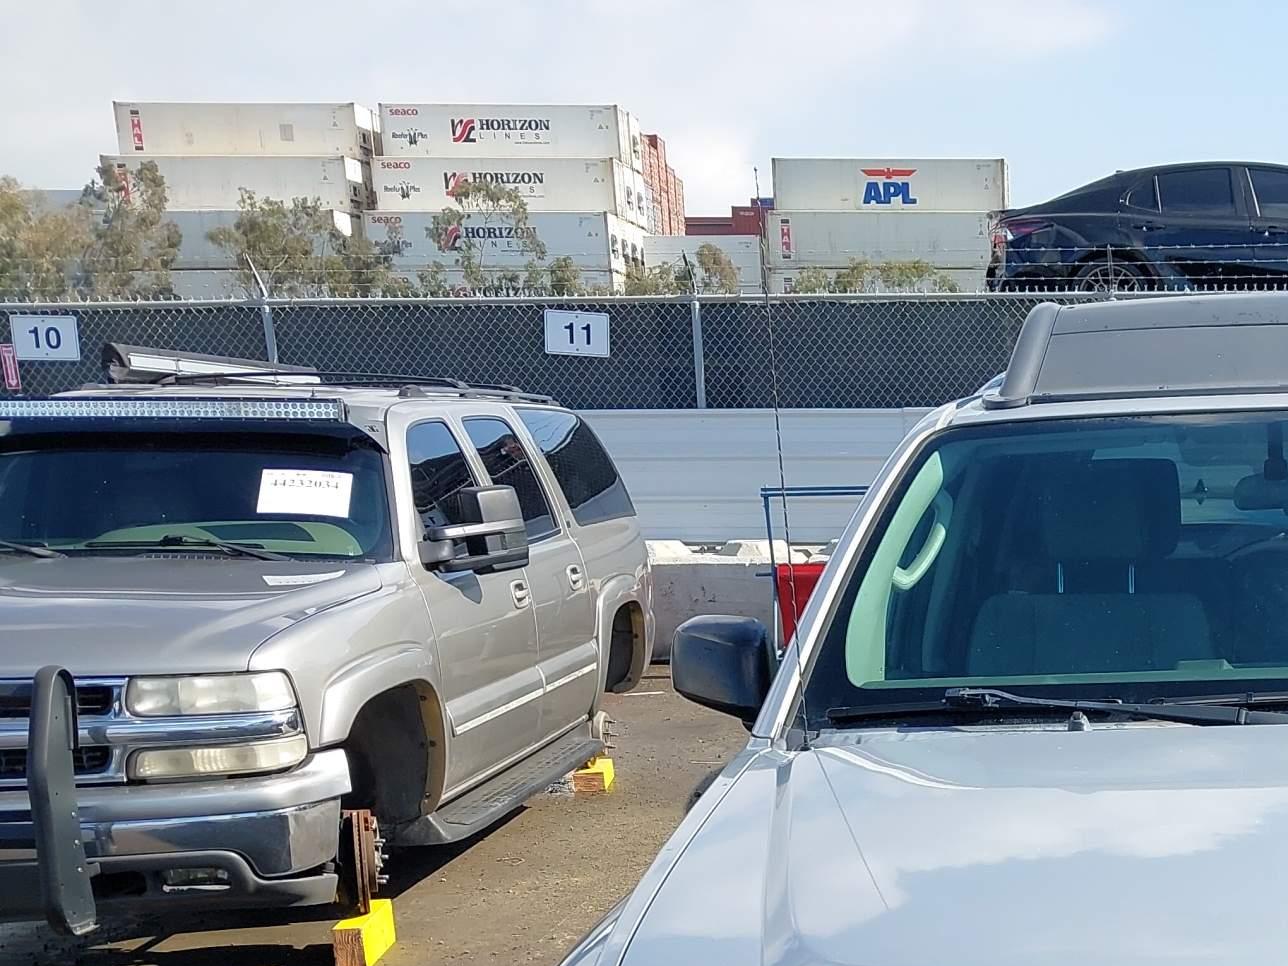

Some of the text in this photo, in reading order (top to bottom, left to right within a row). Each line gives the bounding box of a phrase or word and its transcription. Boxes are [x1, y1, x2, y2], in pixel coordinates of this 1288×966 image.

[389, 107, 418, 116] seaco
[478, 118, 550, 131] HORIZON
[479, 132, 541, 140] LINES
[380, 160, 411, 169] seaco
[471, 172, 544, 184] HORIZON
[863, 181, 917, 205] APL
[371, 215, 402, 224] seaco
[28, 326, 61, 350] 10
[564, 322, 591, 346] 11
